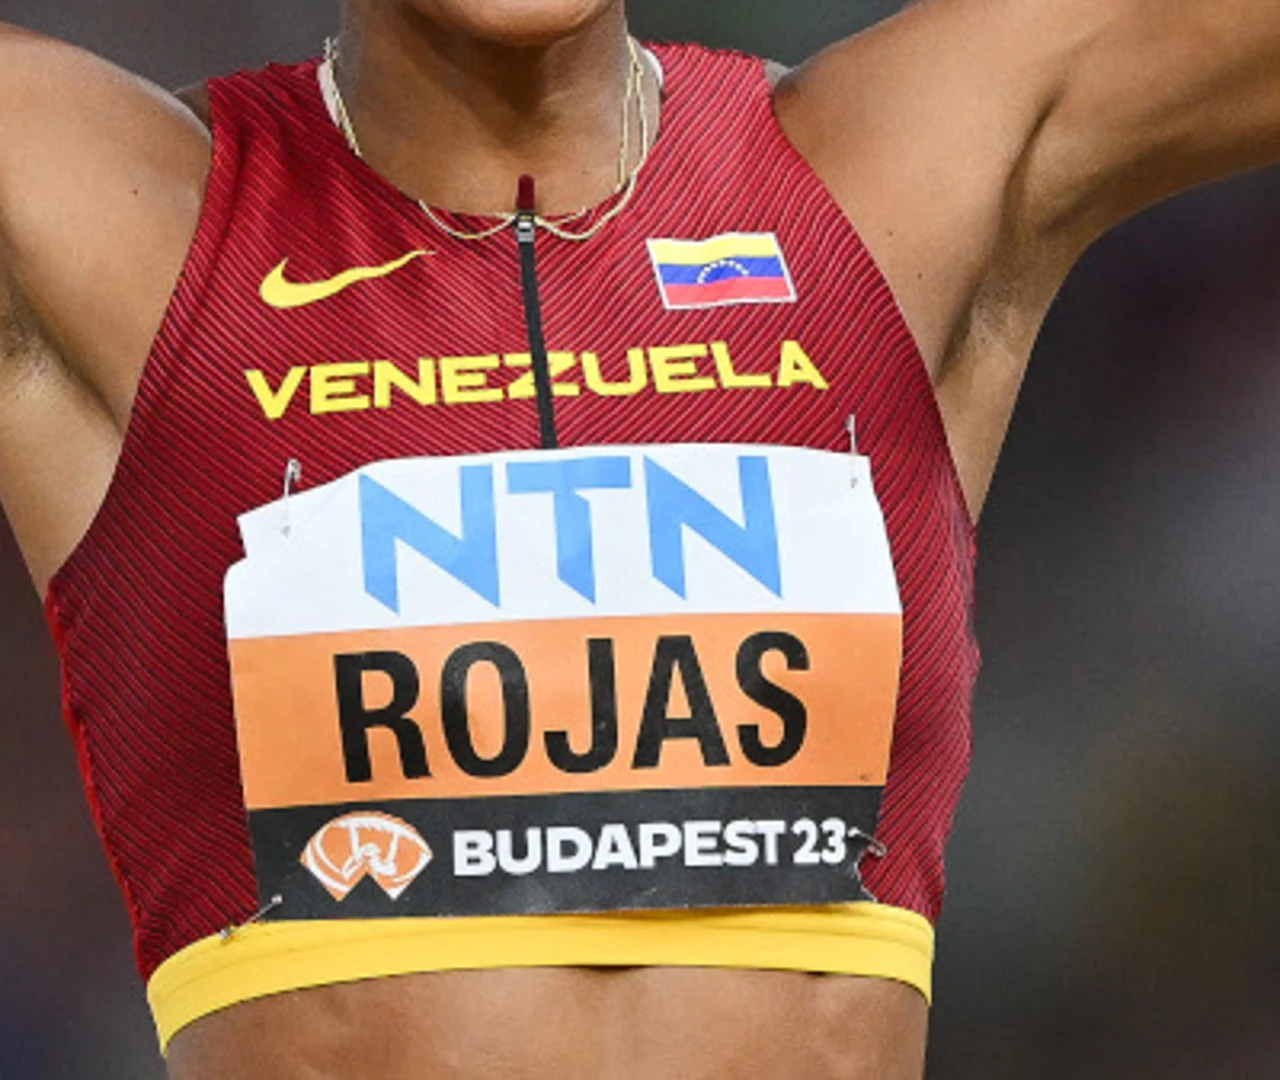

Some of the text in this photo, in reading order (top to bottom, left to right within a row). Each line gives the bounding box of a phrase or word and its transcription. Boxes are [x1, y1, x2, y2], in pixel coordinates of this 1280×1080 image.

[244, 340, 829, 419] VENEZUELA
[358, 455, 782, 615] NTN
[332, 631, 811, 783] ROJAS
[453, 817, 847, 877] BUDAPEST 23
